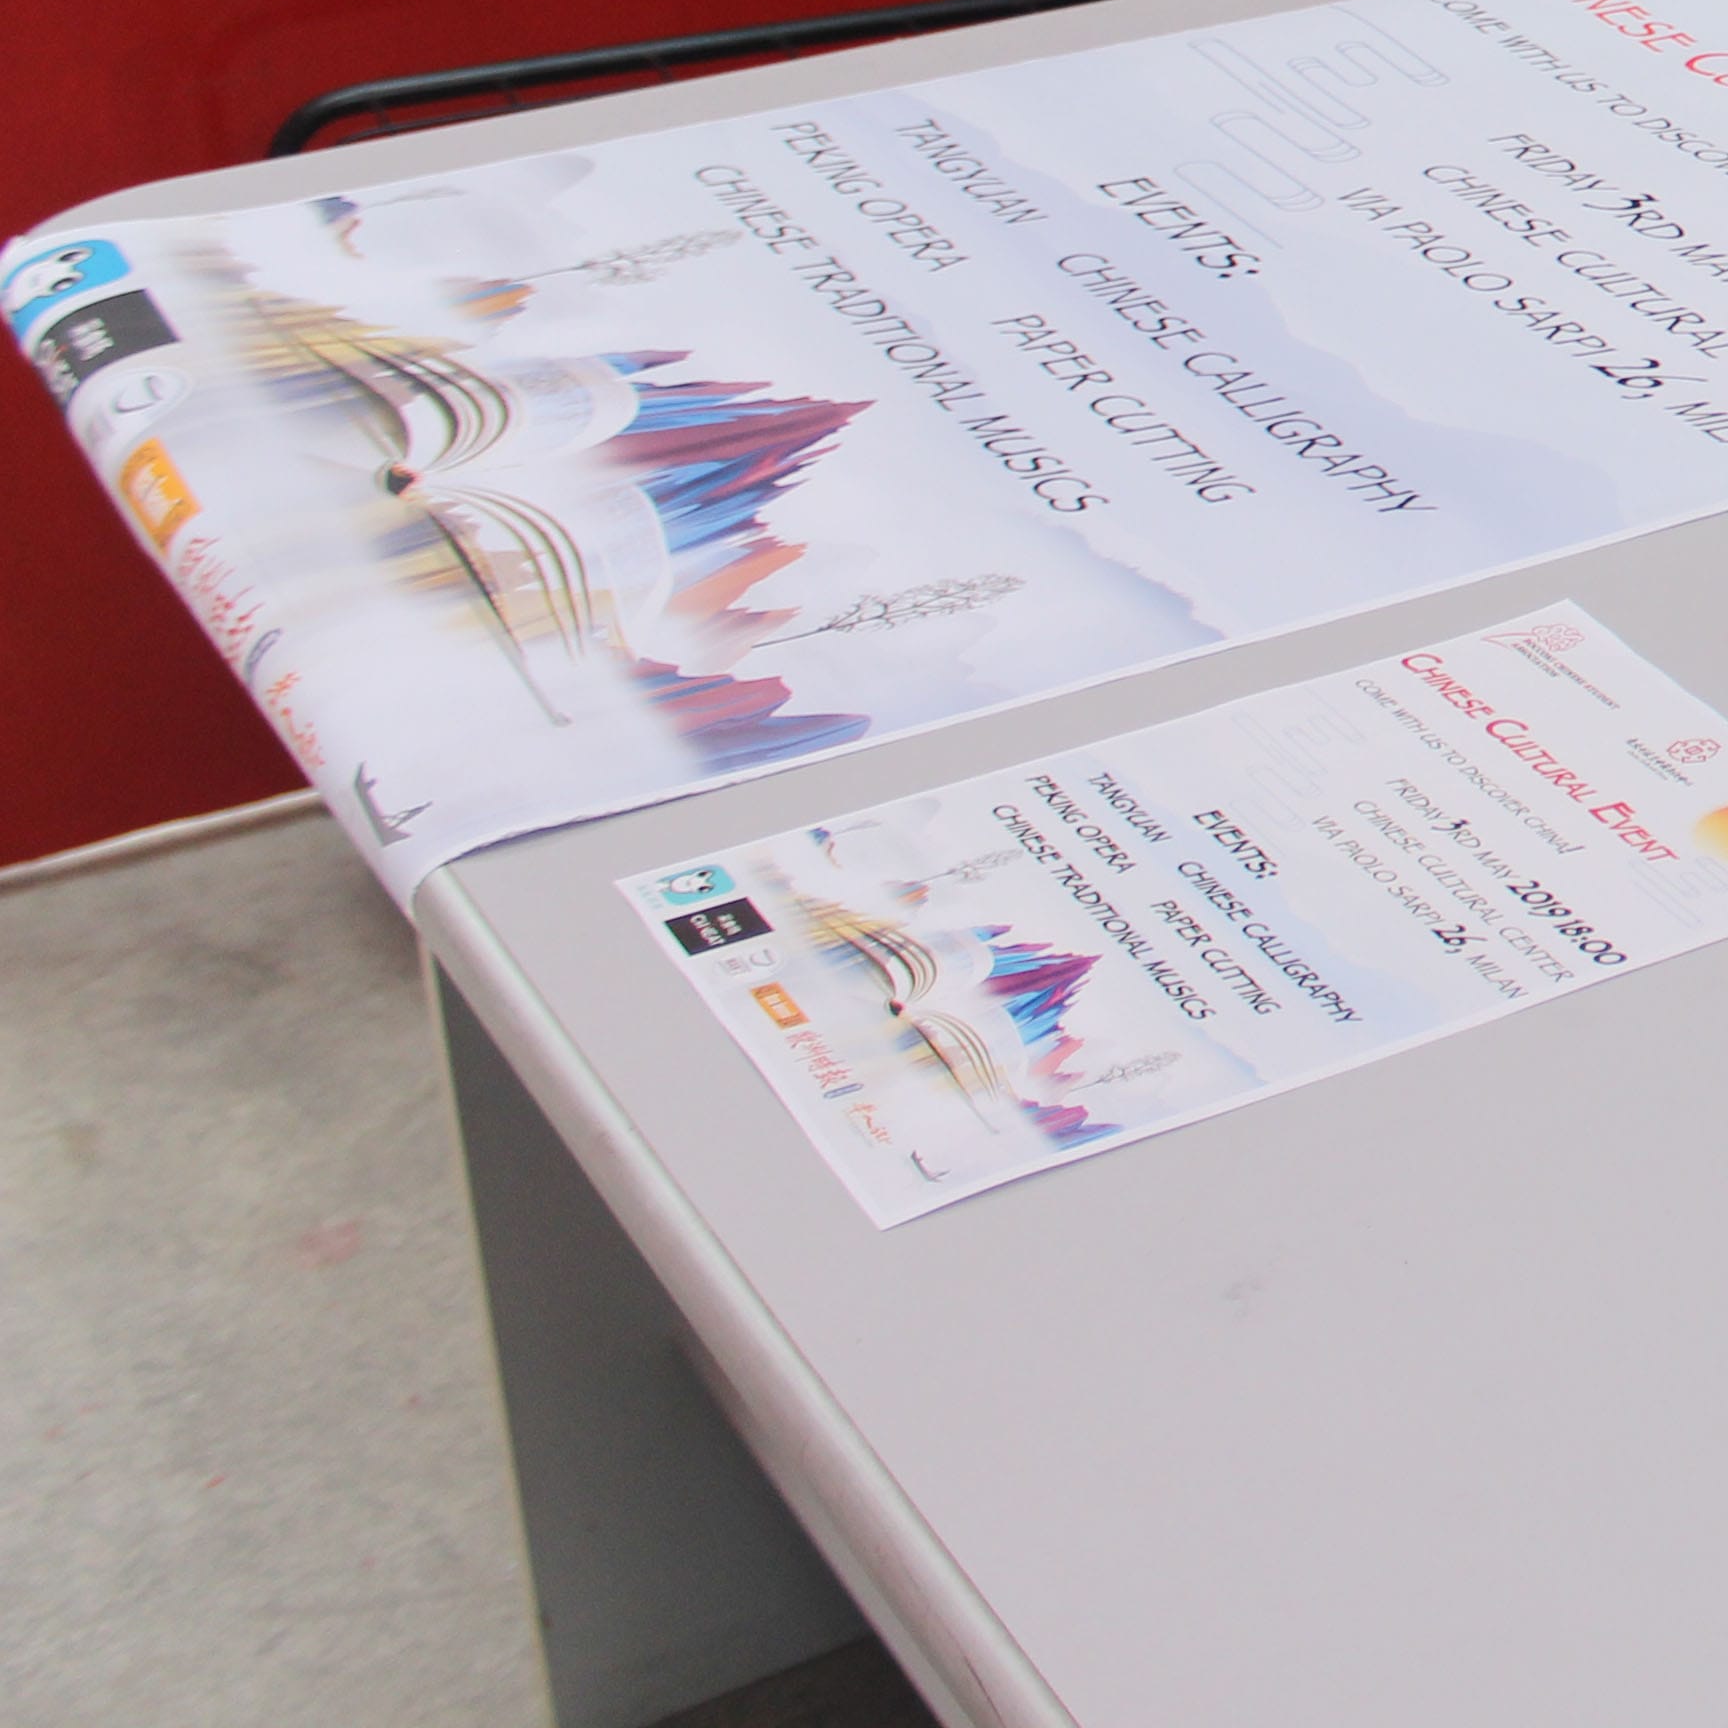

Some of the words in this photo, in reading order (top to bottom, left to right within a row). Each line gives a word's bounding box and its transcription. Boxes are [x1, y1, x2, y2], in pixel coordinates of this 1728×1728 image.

[1499, 34, 1571, 72] WITH
[1555, 72, 1608, 93] US
[1597, 94, 1647, 117] TO
[769, 121, 884, 195] PEKING
[857, 199, 970, 272] OPERA
[895, 119, 1049, 223] TANGYUAN
[1097, 177, 1261, 278] EVENTS:
[1423, 166, 1573, 247] CHINESE
[1488, 133, 1620, 191] FRIDAY
[1582, 194, 1685, 240] 3RD
[696, 166, 819, 255] CHINESE
[791, 256, 986, 411] TRADITIONAL
[959, 414, 1110, 512] MUSICS
[1337, 188, 1402, 221] VIA
[1381, 221, 1514, 292] PAOLO
[1494, 297, 1617, 357] SARPI
[1588, 358, 1708, 399] 26,
[990, 314, 1114, 391] PAPER
[1089, 395, 1256, 503] CUTTING
[1057, 254, 1206, 350] CHINESE
[1183, 352, 1439, 512] CALLIGRAPHY
[1025, 774, 1089, 824] PEKING
[1076, 825, 1137, 874] OPERA
[1088, 772, 1173, 843] TANGYUAN
[1355, 679, 1398, 708] COME
[1392, 708, 1429, 733] WITH
[1420, 733, 1447, 750] US
[1441, 749, 1466, 766] TO
[1459, 766, 1531, 816] DISCOVER
[1524, 816, 1586, 854] CHINA!
[1402, 653, 1494, 719] CHINESE
[1486, 719, 1597, 803] CULTURAL
[1589, 802, 1680, 861] EVENT
[992, 805, 1063, 865] CHINESE
[1050, 863, 1154, 960] TRADITIONAL
[1142, 960, 1216, 1020] MUSICS
[1193, 809, 1279, 879] EVENTS:
[1312, 816, 1344, 840] VIA
[1334, 840, 1398, 883] PAOLO
[1388, 885, 1448, 926] SARPI
[1430, 924, 1488, 954] 26,
[1466, 954, 1529, 999] MILAN
[1354, 800, 1426, 854] CHINESE
[1418, 854, 1503, 926] CULTURAL
[1499, 926, 1574, 983] CENTER
[1385, 778, 1450, 820] FRIDAY
[1431, 819, 1481, 849] 3RD
[1473, 851, 1520, 879] MAY
[1505, 880, 1572, 917] 2019
[1553, 919, 1627, 965] 18:00
[1150, 900, 1212, 947] PAPER
[1201, 948, 1282, 1014] CUTTING
[1178, 861, 1254, 922] CHINESE
[1243, 923, 1363, 1023] CALLIGRAPHY
